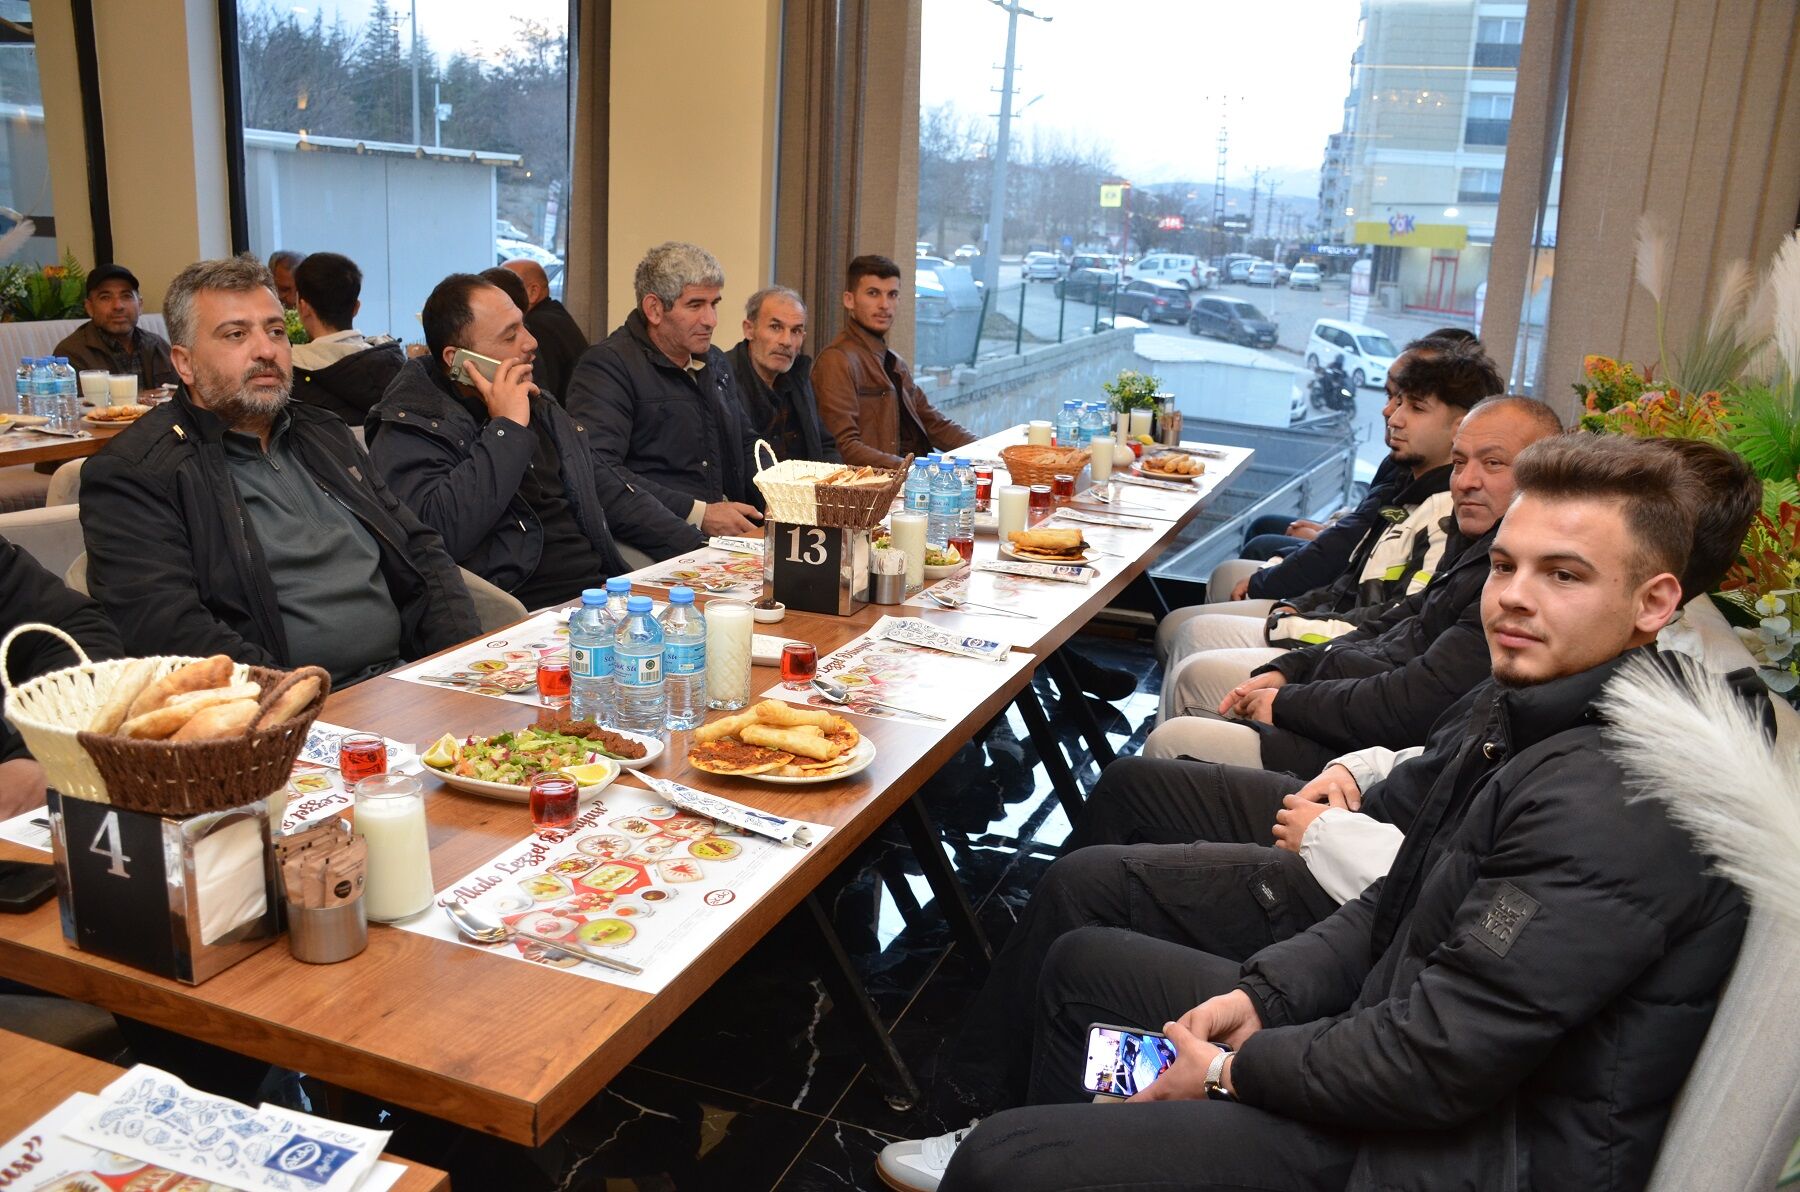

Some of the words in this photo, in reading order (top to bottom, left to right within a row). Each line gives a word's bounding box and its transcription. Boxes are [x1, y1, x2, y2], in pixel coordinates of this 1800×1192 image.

[785, 526, 828, 565] 13
[89, 810, 132, 879] 4
[494, 842, 550, 875] Lezzet
